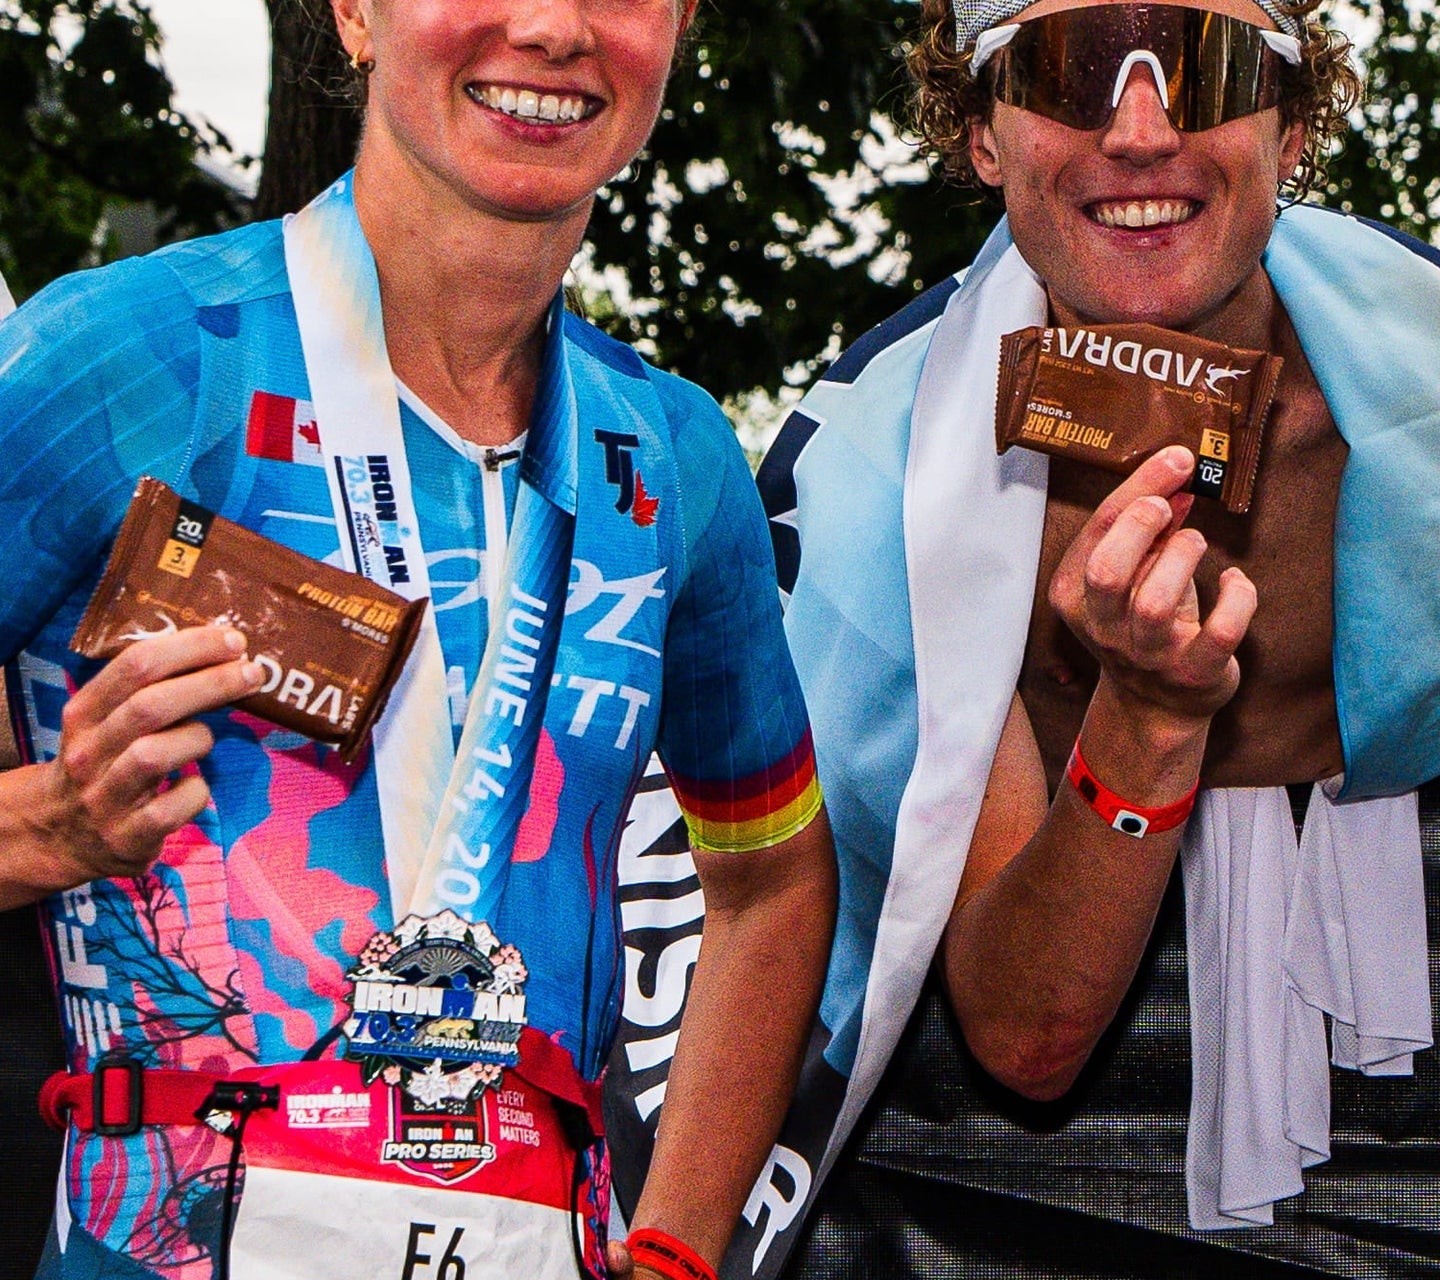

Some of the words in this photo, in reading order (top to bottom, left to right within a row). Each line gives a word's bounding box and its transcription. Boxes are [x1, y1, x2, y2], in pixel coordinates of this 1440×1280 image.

[1057, 328, 1203, 387] ADDRA
[1024, 412, 1056, 435] BAR
[1055, 420, 1114, 450] PROTEIN
[484, 583, 548, 727] JUNE
[254, 654, 343, 725] DRA
[426, 833, 490, 923] 20
[353, 973, 527, 1025] IRONMAN
[423, 1035, 518, 1054] PENNSYLVANIA
[497, 1091, 525, 1107] EVERY
[498, 1107, 535, 1128] SECOND
[500, 1125, 540, 1147] MATTERS
[385, 1143, 427, 1159] PRO
[428, 1144, 494, 1160] SERIES
